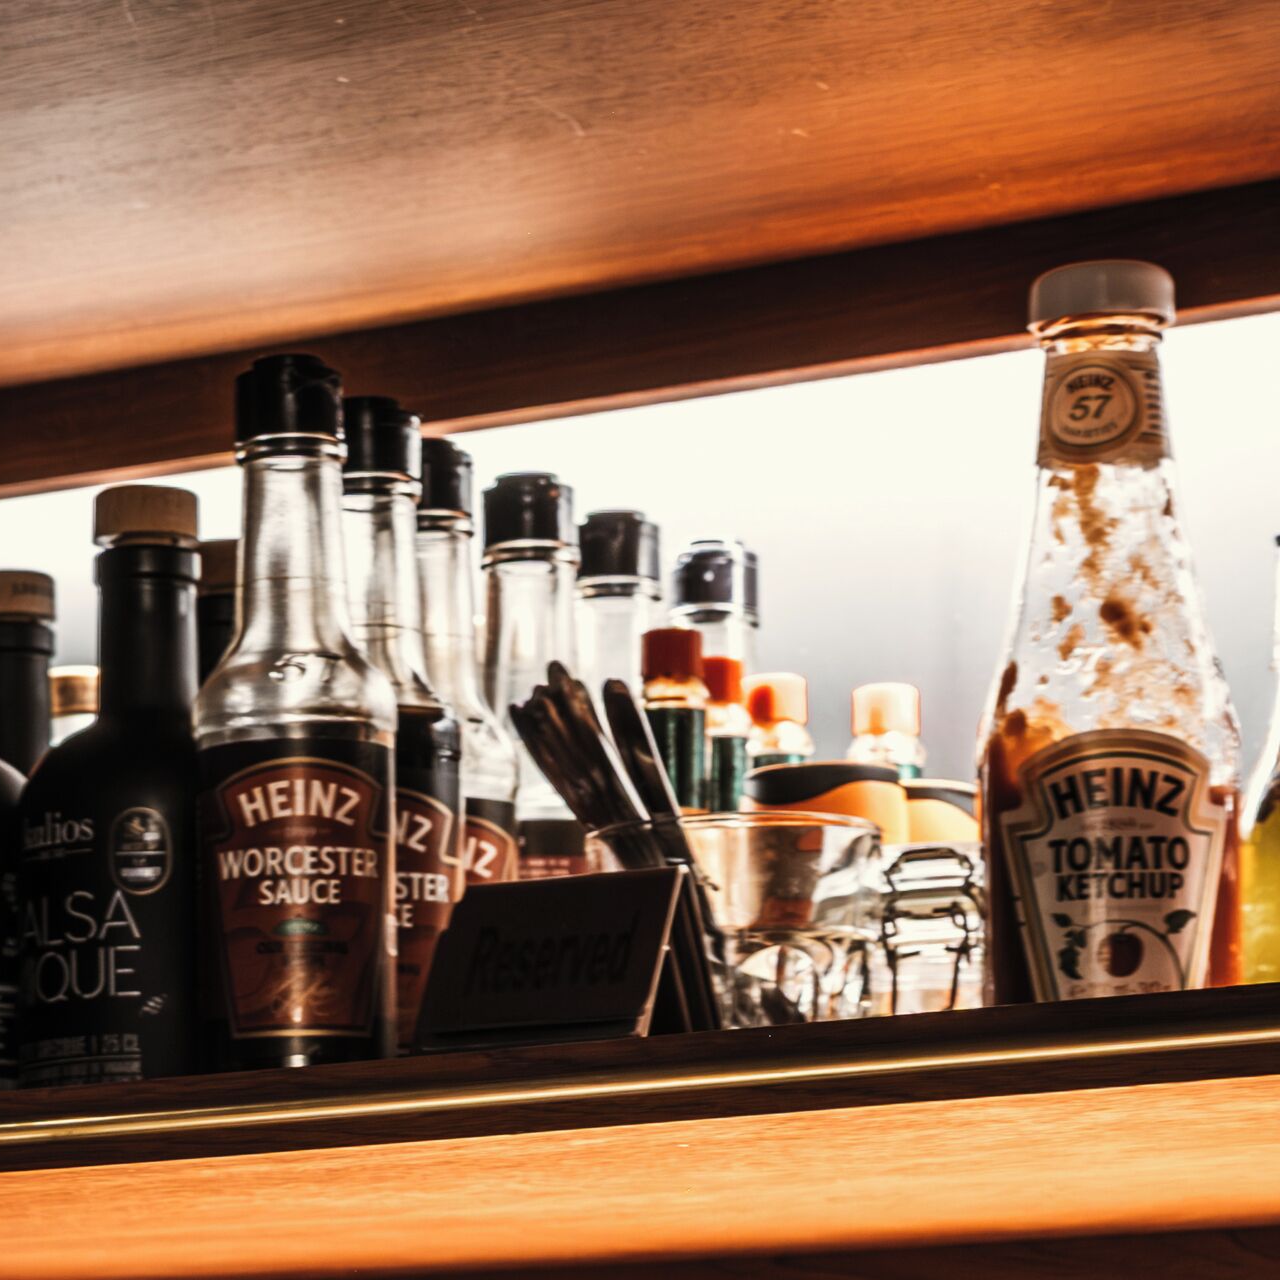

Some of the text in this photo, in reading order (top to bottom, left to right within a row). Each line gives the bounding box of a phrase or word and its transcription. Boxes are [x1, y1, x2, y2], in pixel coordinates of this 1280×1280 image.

[1069, 394, 1113, 421] 57
[238, 778, 361, 827] HEINZ
[1049, 766, 1185, 820] HEINZ
[220, 845, 379, 880] WORCESTER
[1048, 836, 1191, 873] TOMATO
[259, 879, 341, 904] SAUCE
[1055, 872, 1185, 902] KETCHUP
[24, 889, 141, 946] ALSA
[35, 945, 141, 1002] QUE
